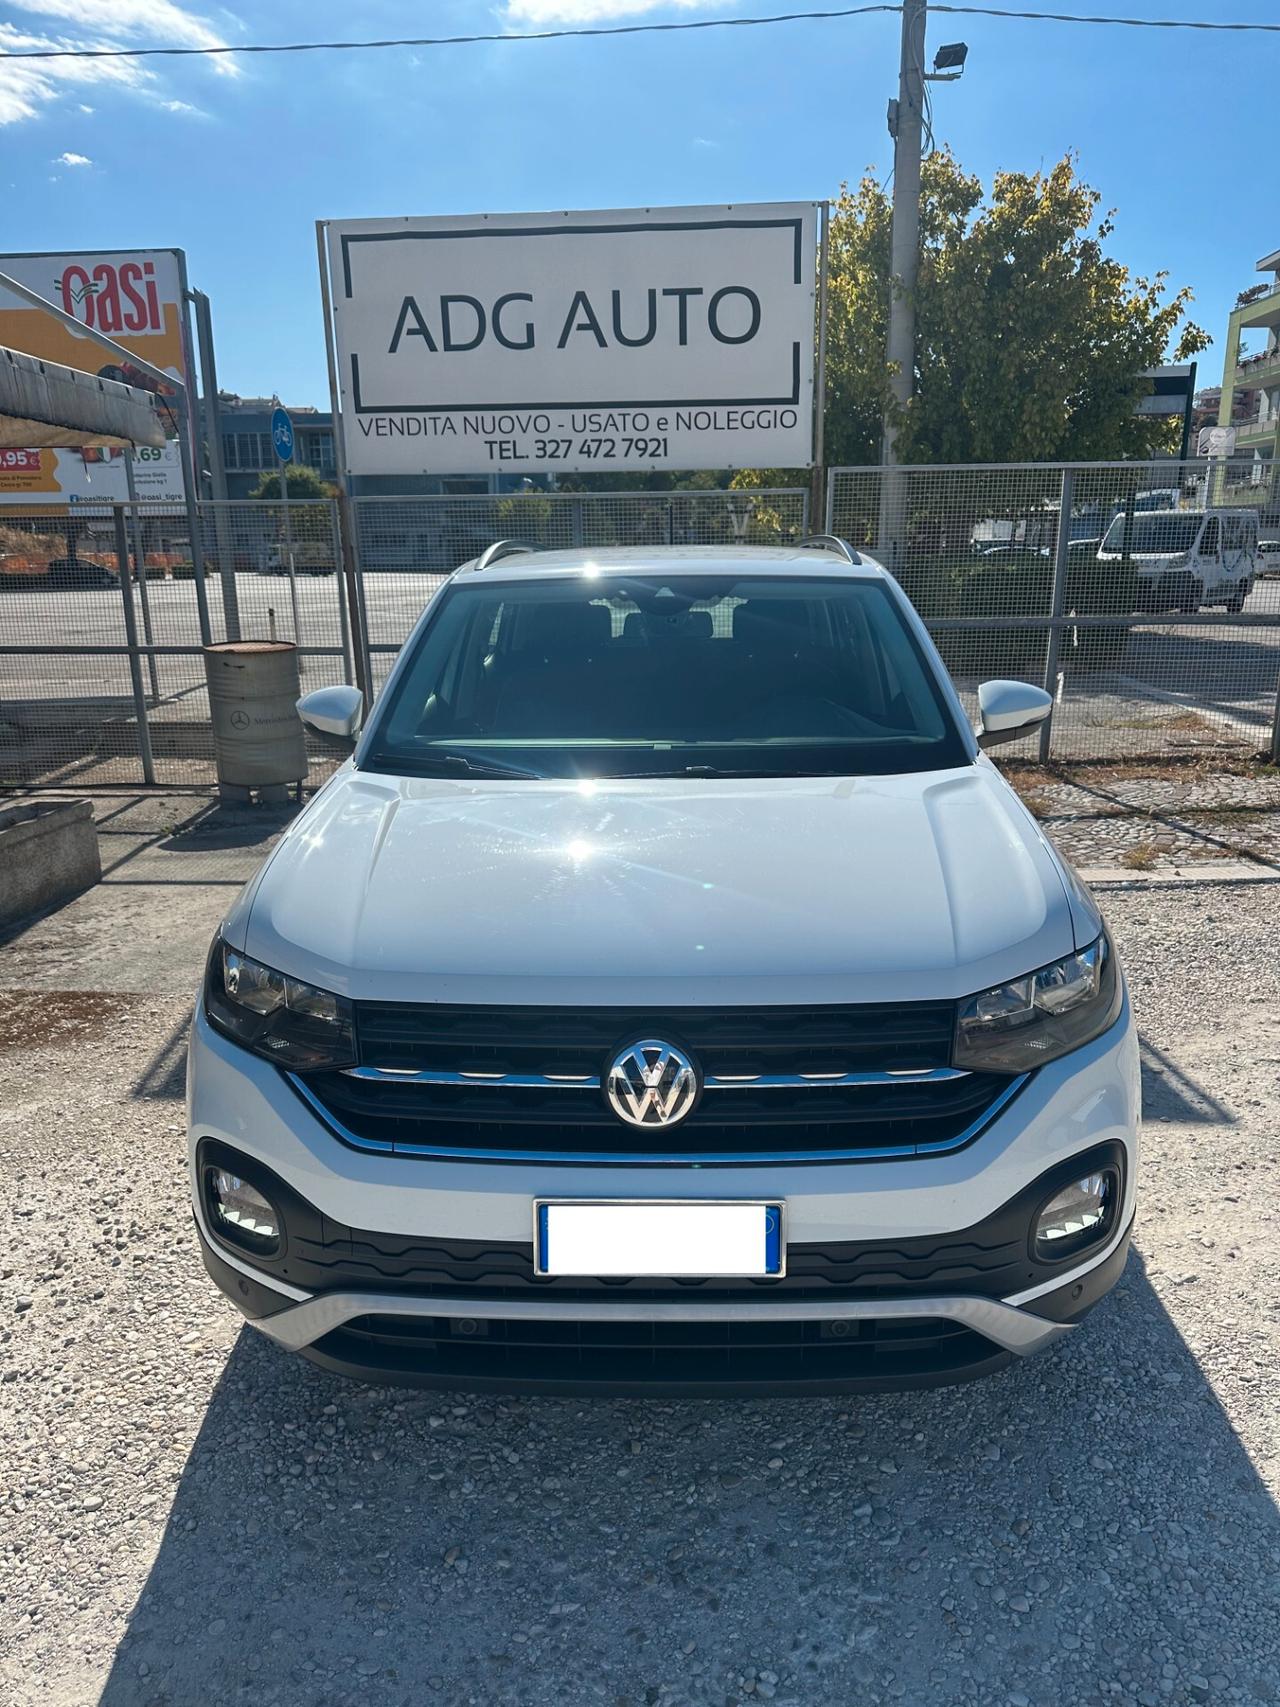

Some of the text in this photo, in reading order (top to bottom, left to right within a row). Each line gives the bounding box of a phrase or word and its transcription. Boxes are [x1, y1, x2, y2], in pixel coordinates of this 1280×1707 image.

[388, 286, 761, 353] ADG AUTO
[358, 417, 457, 436] VENDITA
[463, 415, 551, 434] NUOVO
[571, 413, 650, 433] USATO
[656, 417, 669, 431] e
[676, 410, 798, 431] NOLEGGIO
[484, 438, 668, 460] TEL. 327 472 7921
[141, 493, 183, 501] @oasi_tigre
